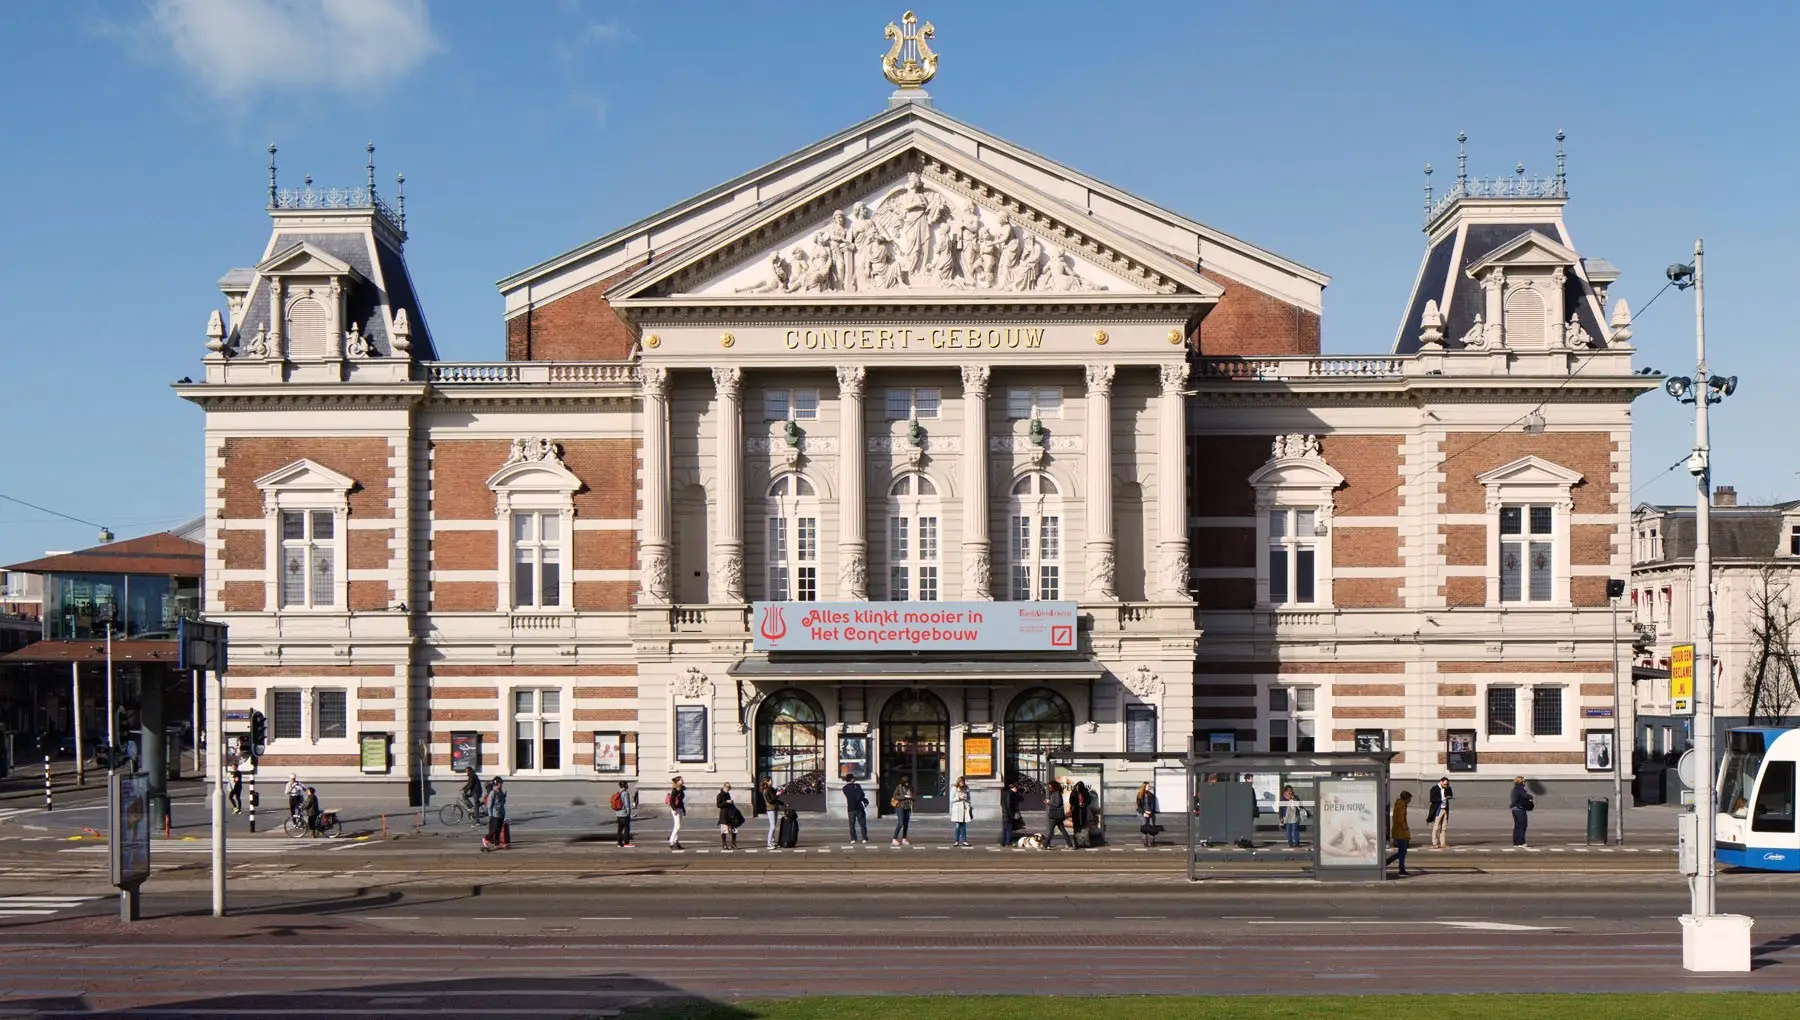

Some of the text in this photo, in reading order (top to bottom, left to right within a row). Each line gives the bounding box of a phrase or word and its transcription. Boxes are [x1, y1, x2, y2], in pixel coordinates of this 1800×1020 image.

[786, 327, 1045, 350] CONCERT-GEBOUW
[801, 609, 983, 627] Alles klinkt mooier in
[811, 627, 978, 644] Het Concertgebouw
[1672, 665, 1692, 679] RECLAME
[1324, 802, 1366, 812] OPEN NOW
